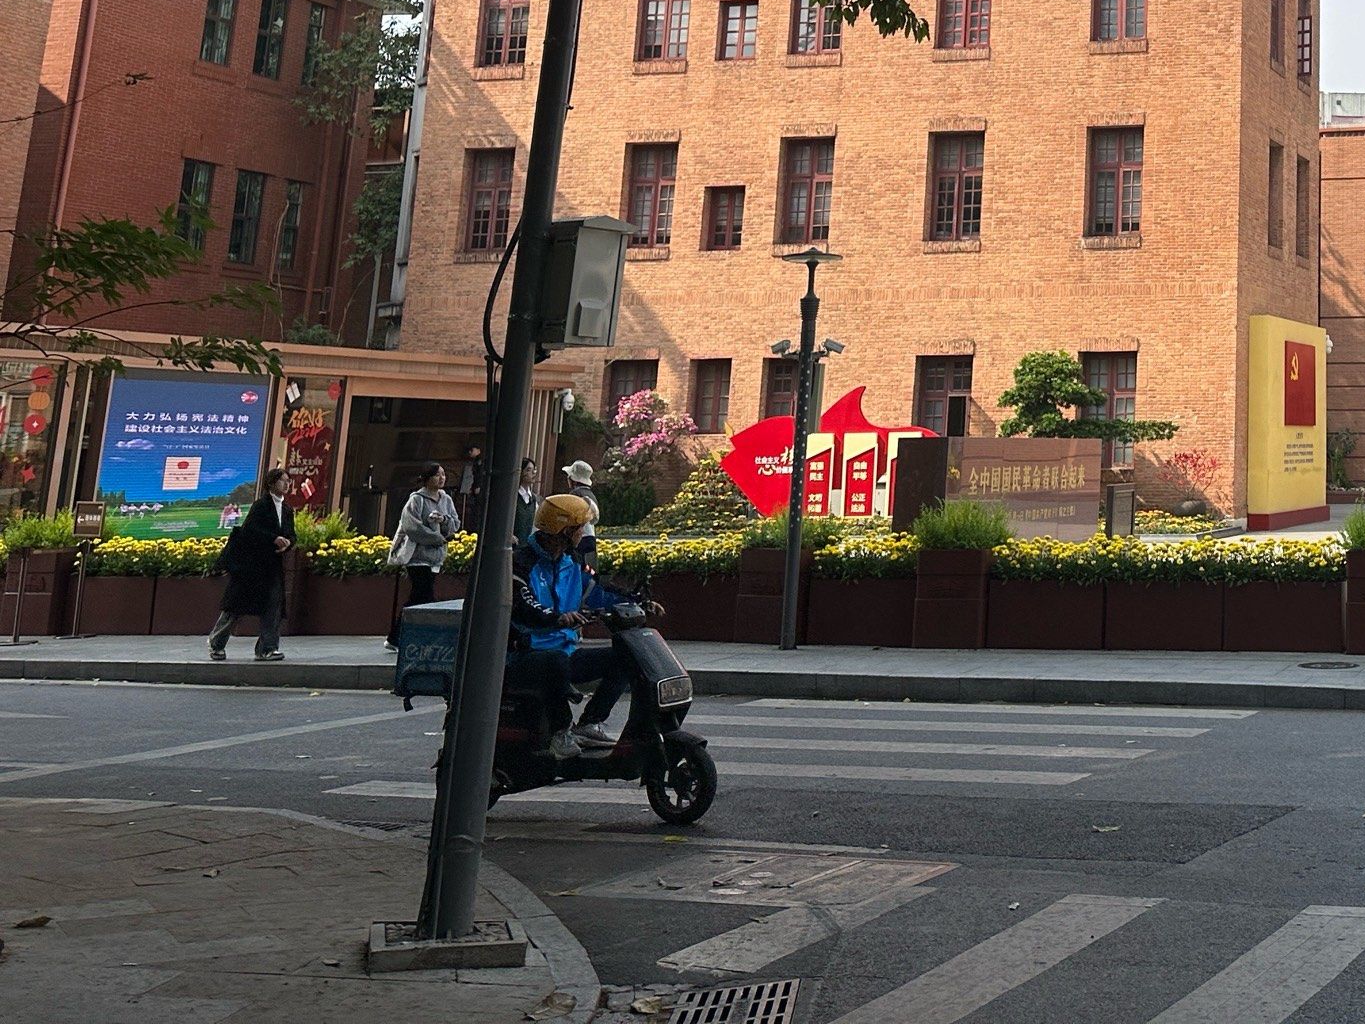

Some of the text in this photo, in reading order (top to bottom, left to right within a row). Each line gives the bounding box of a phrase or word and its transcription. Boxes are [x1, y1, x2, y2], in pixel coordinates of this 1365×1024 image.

[125, 411, 250, 423] 大力弘扬宪法精神
[124, 424, 248, 435] 建设社会主义法治文化
[853, 461, 868, 470] 自由
[809, 472, 824, 481] 民主
[968, 463, 1086, 495] 全中国国民革命者联合起来
[808, 493, 823, 503] 文明
[851, 493, 867, 502] 公正
